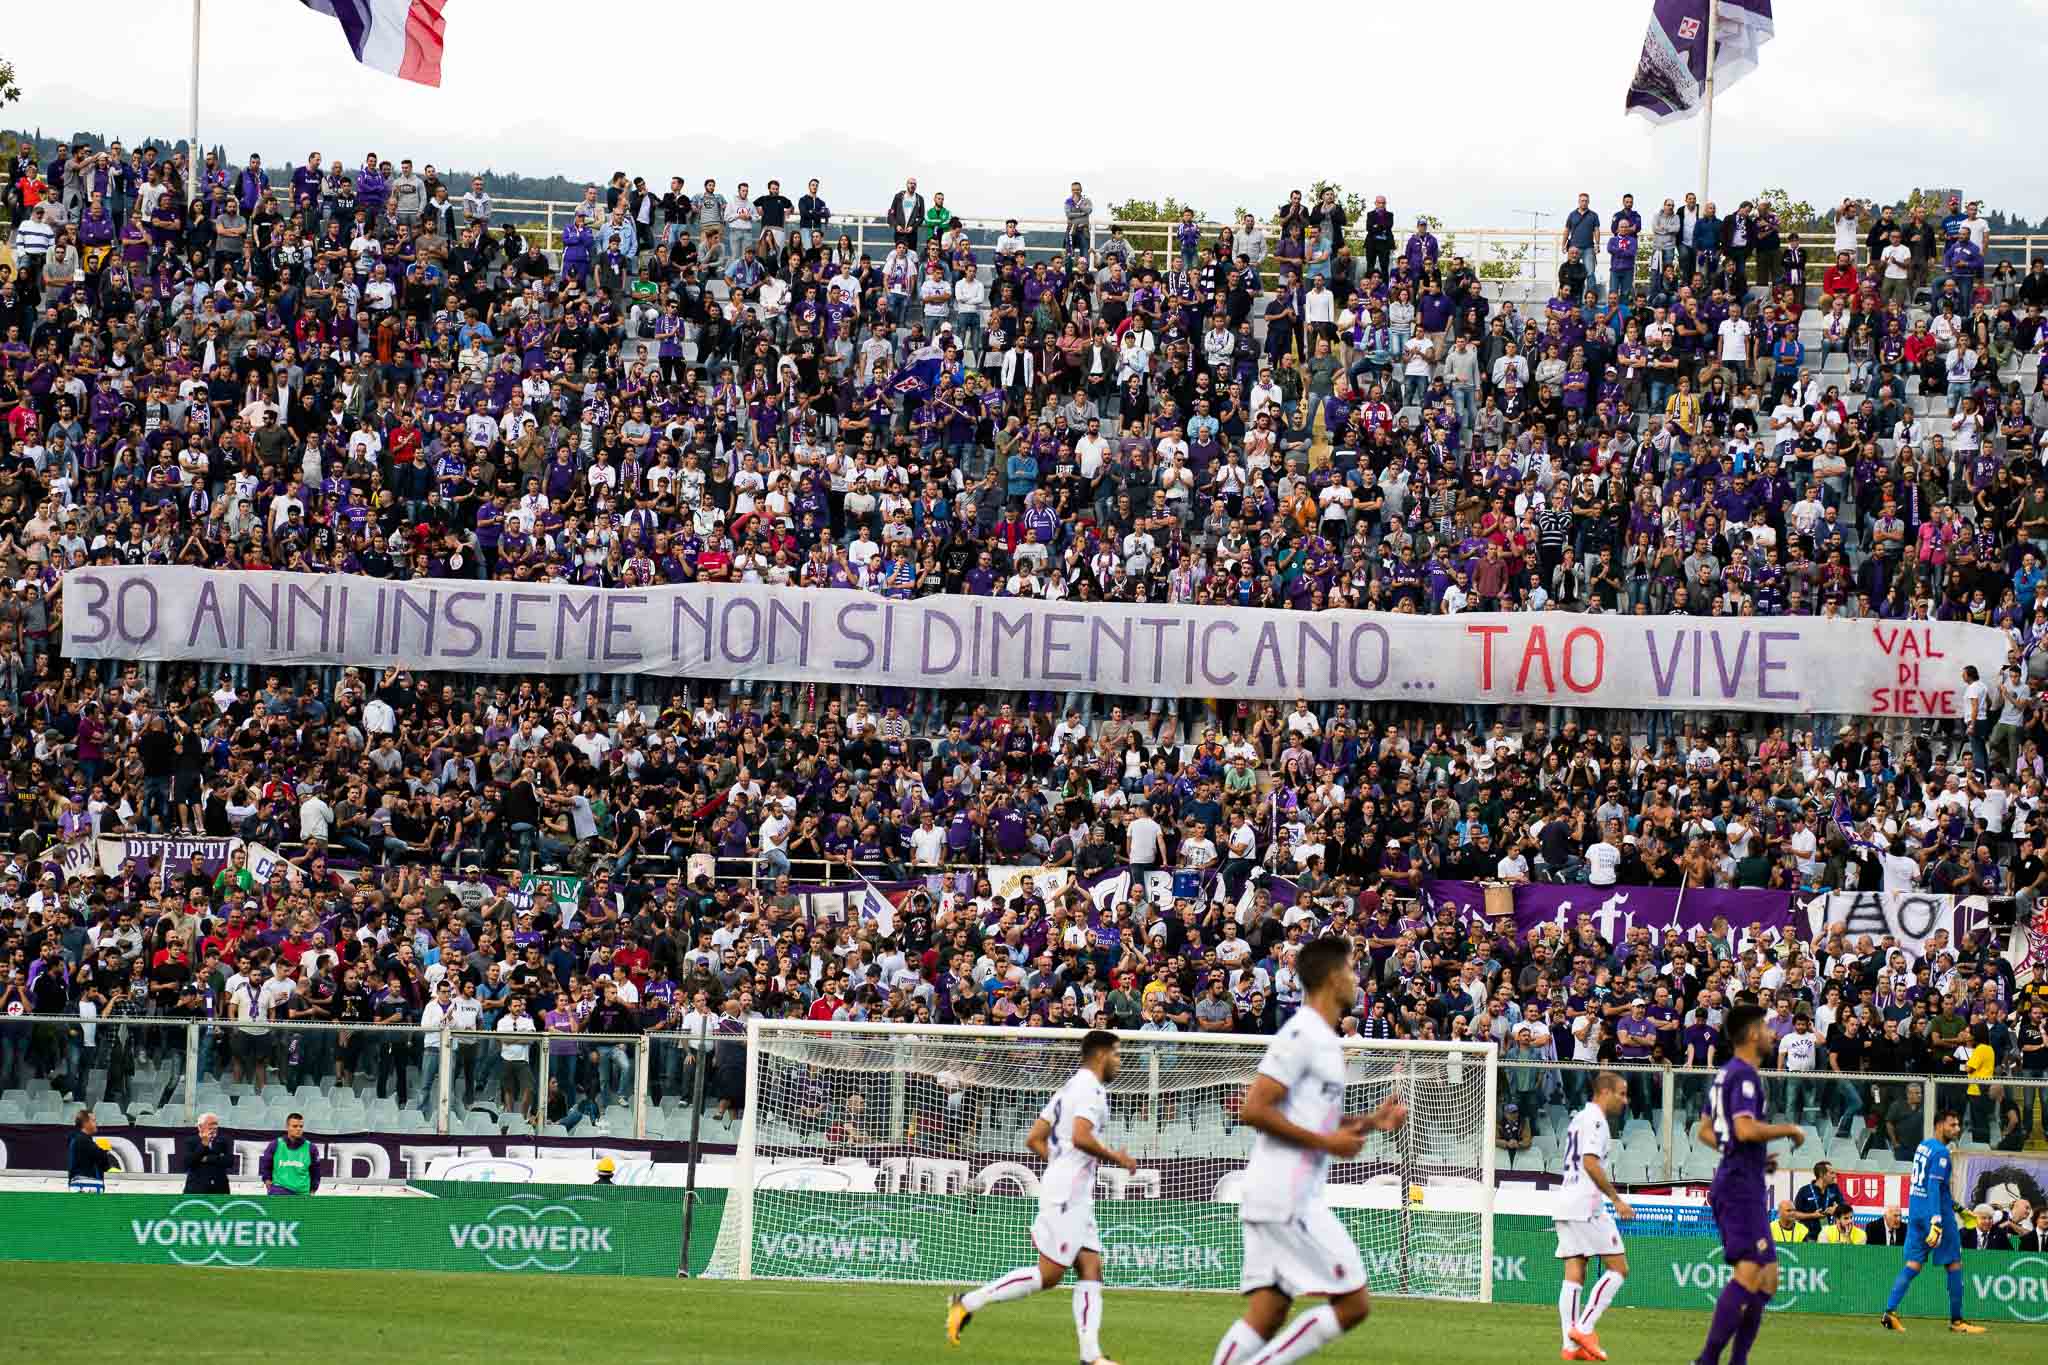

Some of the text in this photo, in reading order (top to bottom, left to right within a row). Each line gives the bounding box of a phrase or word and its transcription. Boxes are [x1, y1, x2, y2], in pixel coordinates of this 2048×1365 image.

[71, 576, 1800, 701] 30 ANNI INSIEME NON SI DIMENTICANO... TAO VIVE
[1872, 626, 1945, 658] VAL
[1899, 663, 1920, 687] DI
[1871, 688, 1957, 715] SIEVE
[131, 1218, 300, 1248] VORWERK
[449, 1223, 613, 1253] VORWERK
[760, 1231, 920, 1263] VORWERK
[1100, 1243, 1225, 1271] RWERK
[1671, 1261, 1829, 1294] VORERK
